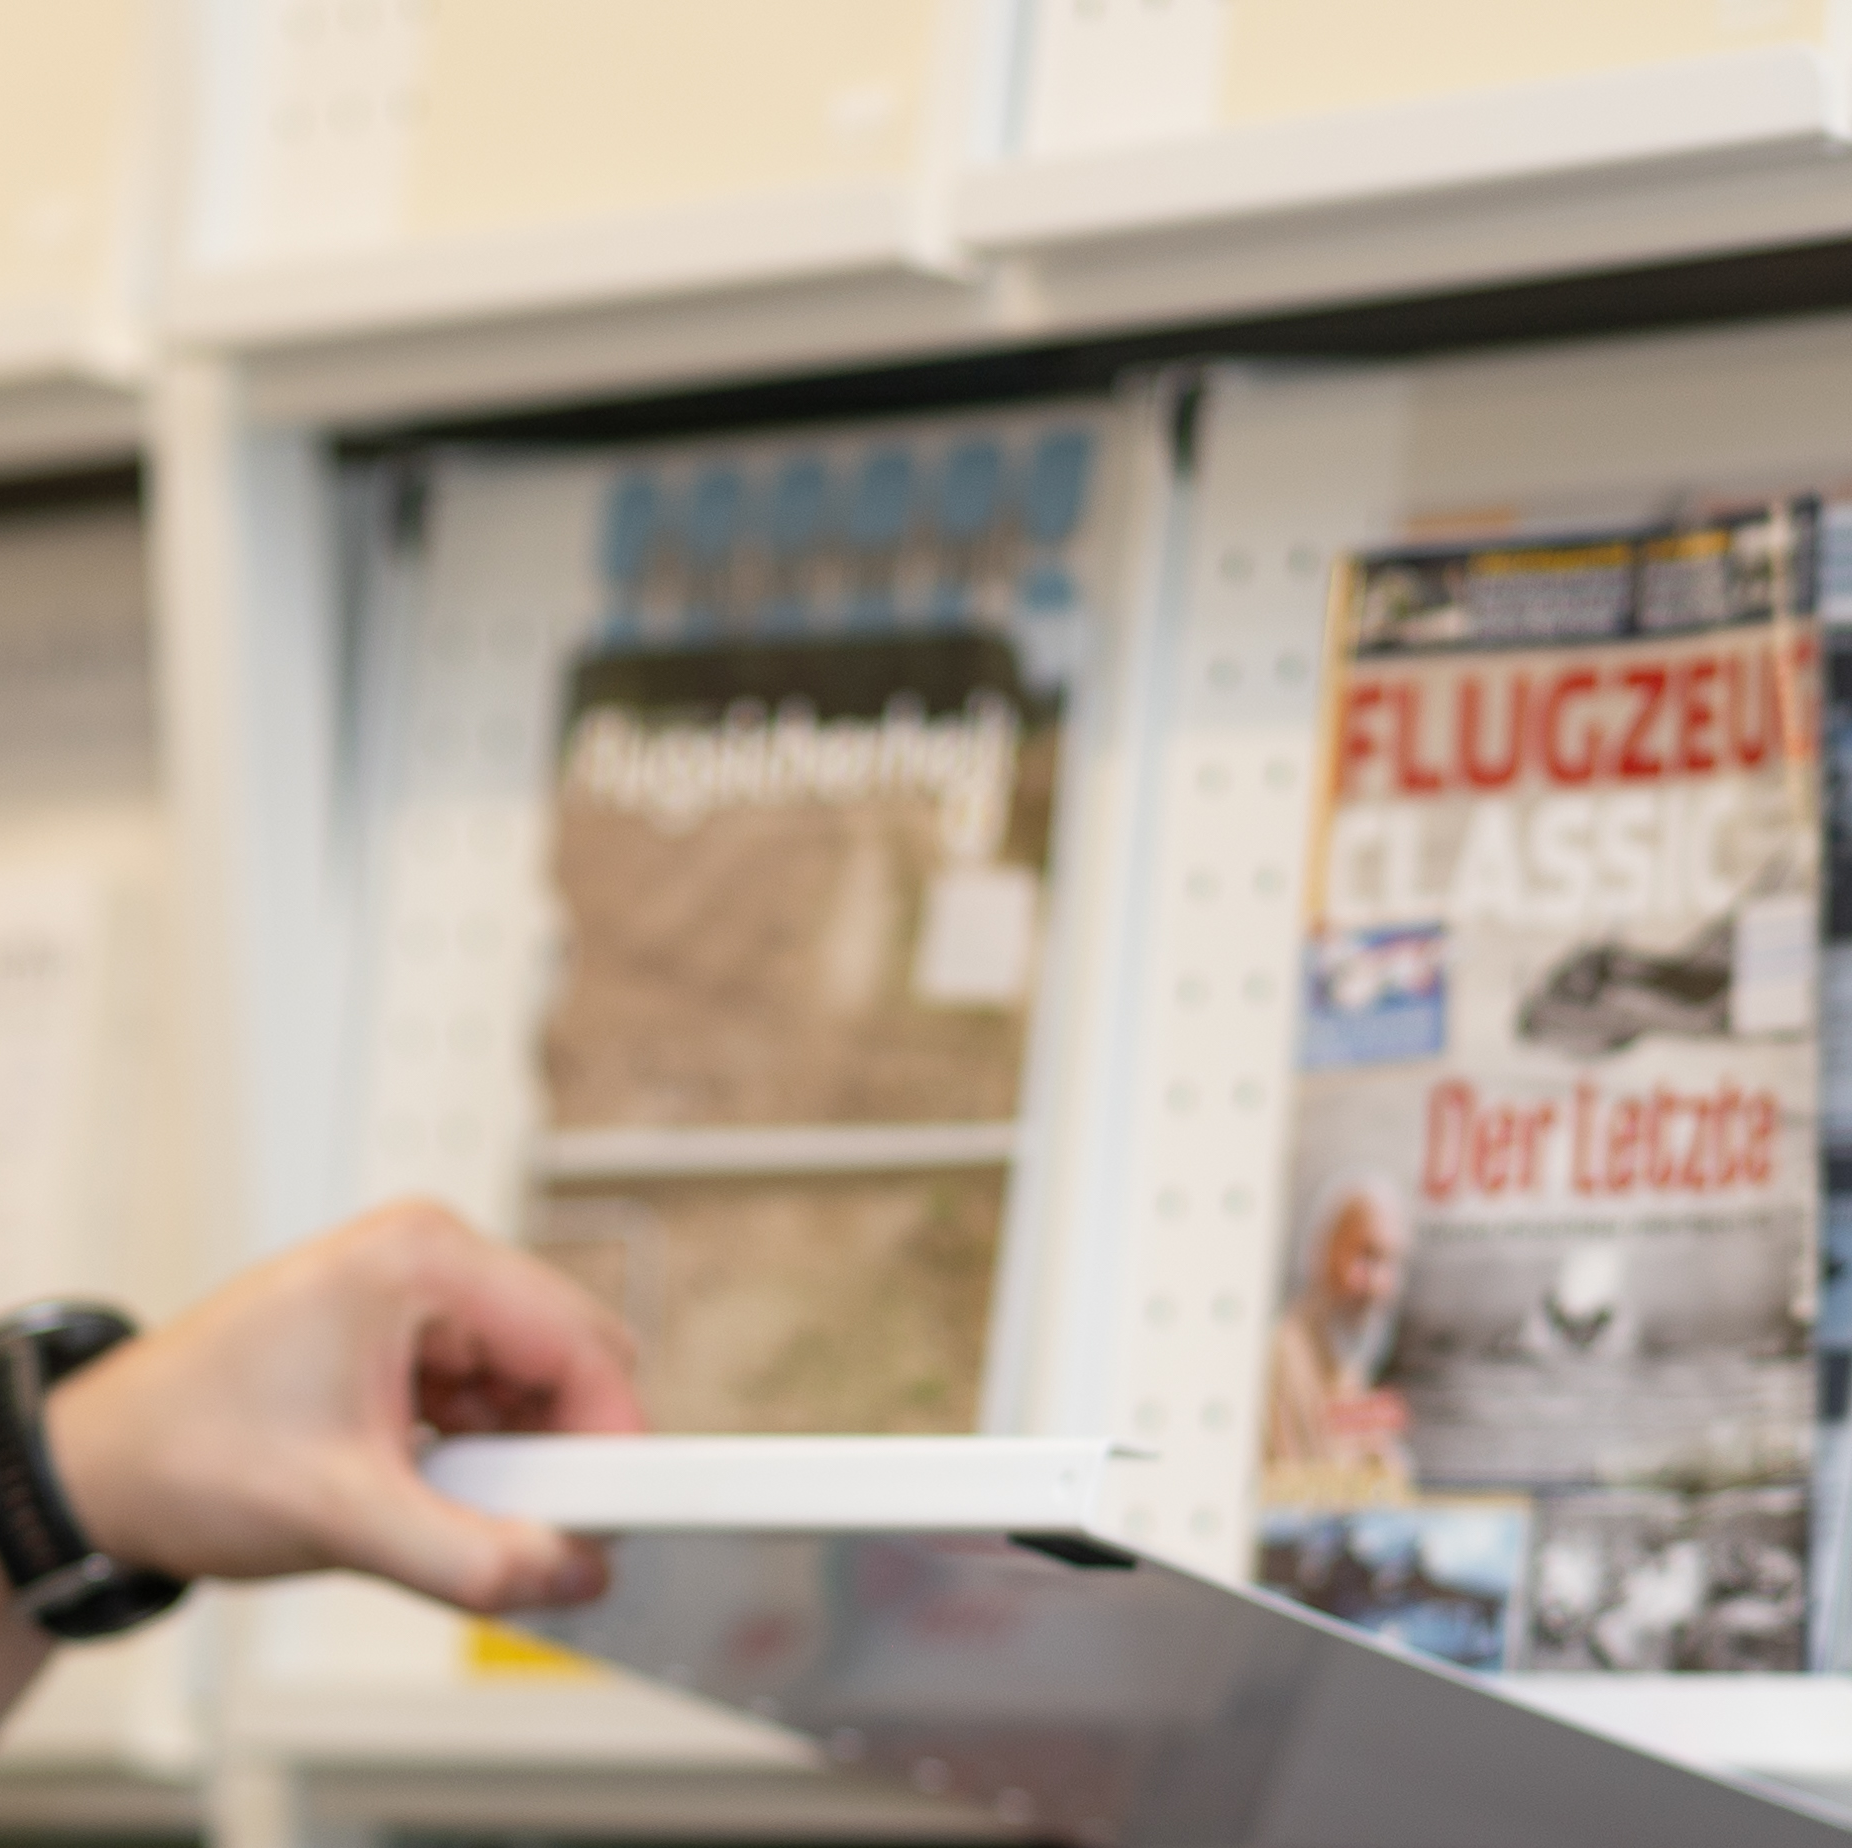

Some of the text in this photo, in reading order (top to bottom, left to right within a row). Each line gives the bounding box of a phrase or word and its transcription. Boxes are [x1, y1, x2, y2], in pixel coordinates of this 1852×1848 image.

[1326, 780, 1755, 922] CLASSIC
[1419, 1080, 1783, 1204] Der Letzte
